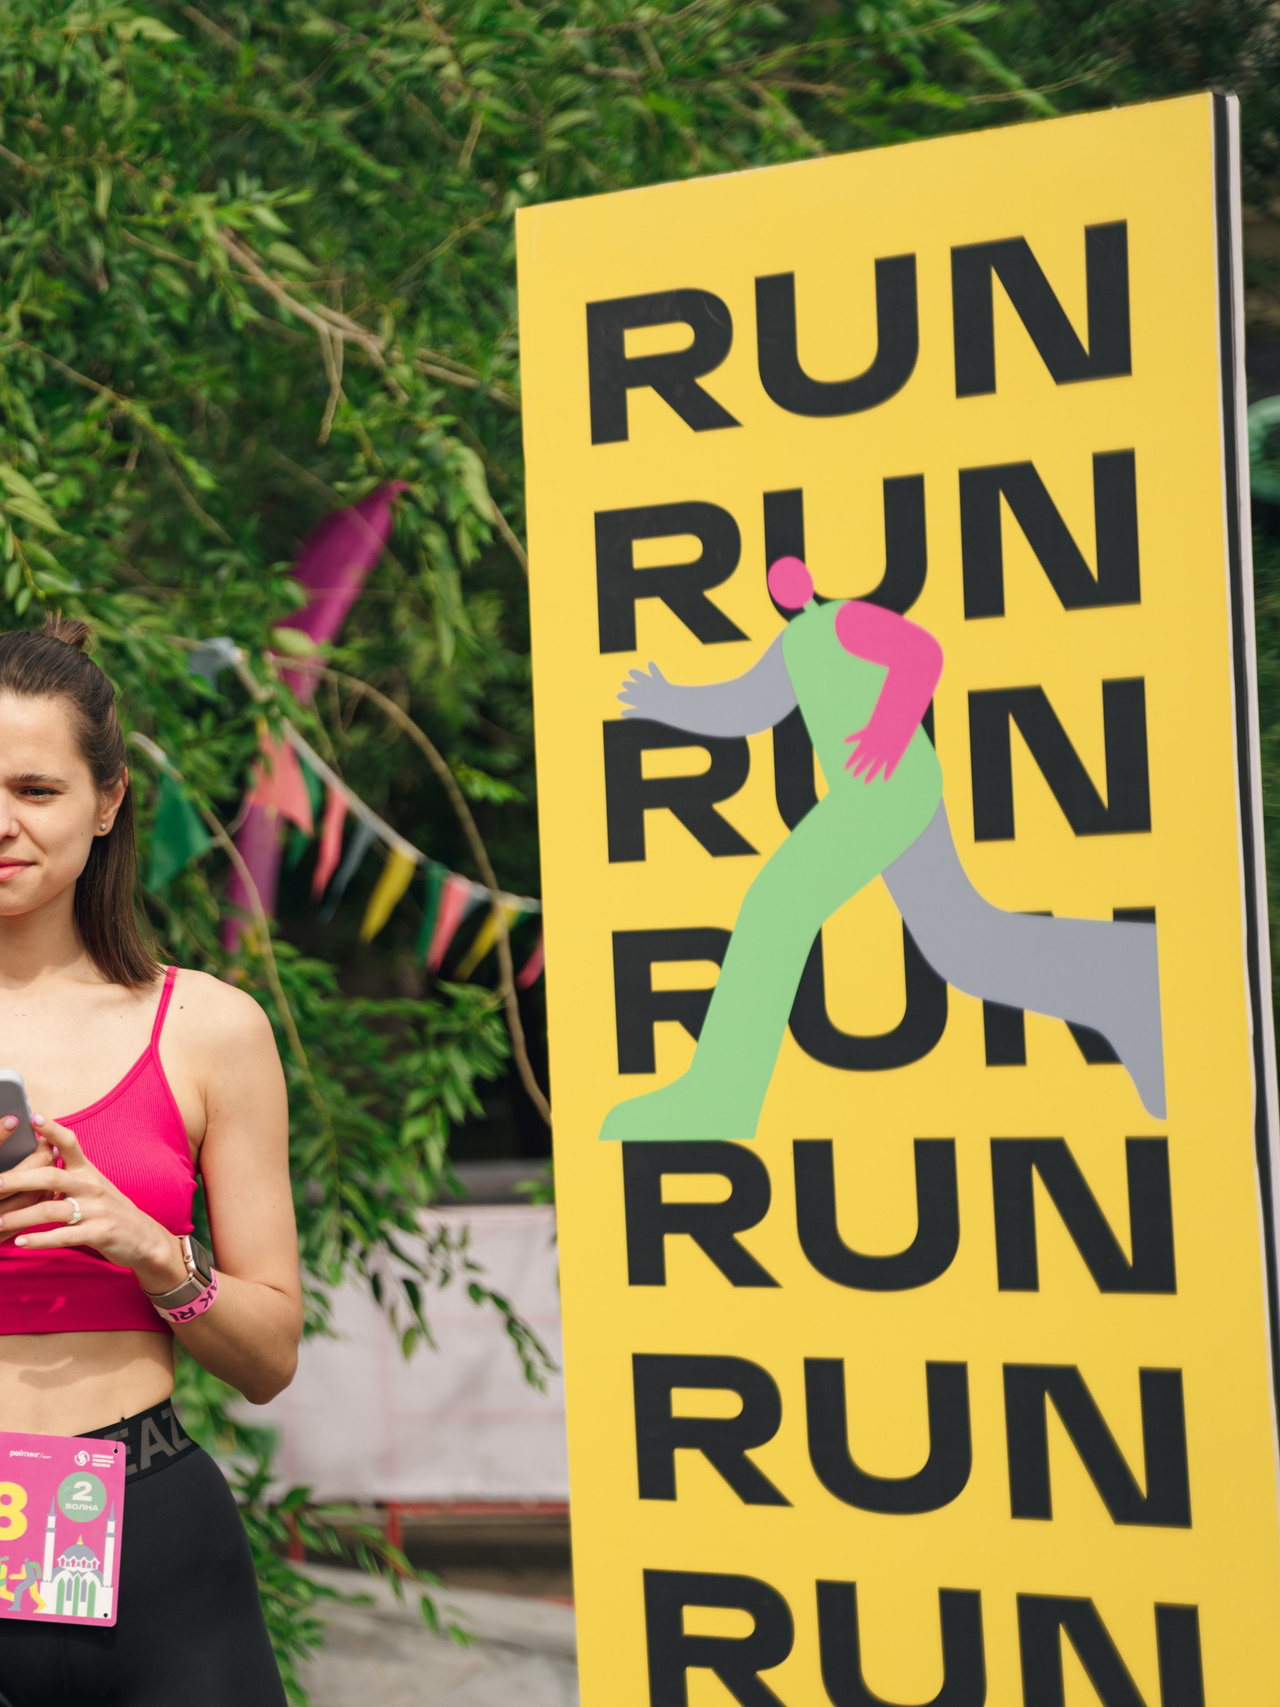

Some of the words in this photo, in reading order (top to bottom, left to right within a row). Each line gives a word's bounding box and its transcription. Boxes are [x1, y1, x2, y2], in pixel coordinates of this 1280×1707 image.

[585, 219, 1133, 446] RUN
[593, 447, 1142, 655] RUN
[621, 1135, 1178, 1295] RUN
[65, 1503, 99, 1511] ВОЛНА
[72, 1481, 93, 1502] 2
[631, 1352, 1193, 1529] RUN
[642, 1568, 1206, 1707] RUN
